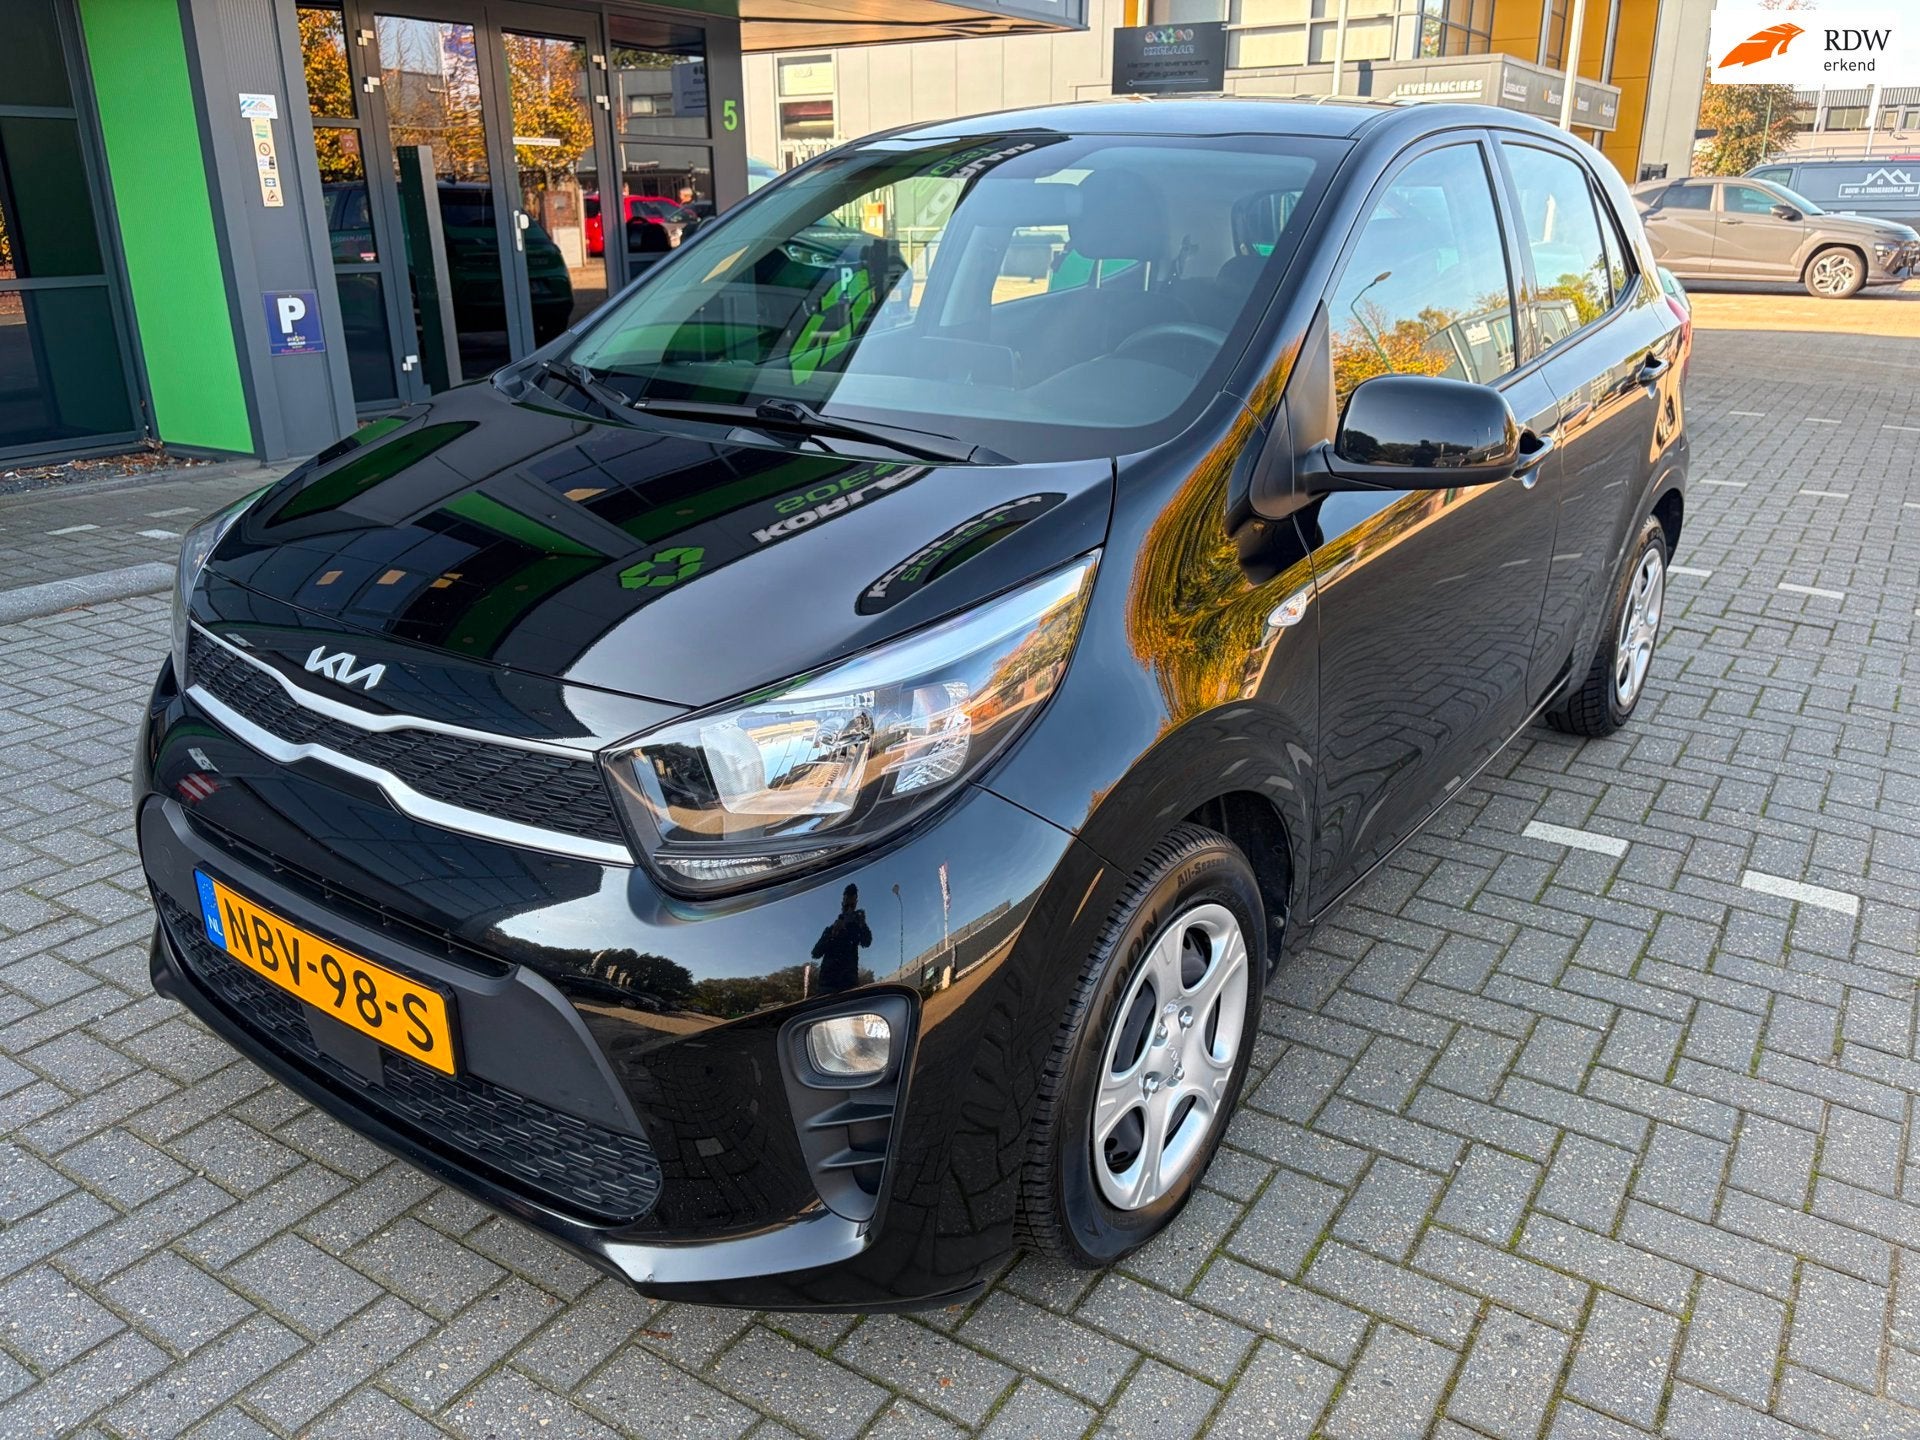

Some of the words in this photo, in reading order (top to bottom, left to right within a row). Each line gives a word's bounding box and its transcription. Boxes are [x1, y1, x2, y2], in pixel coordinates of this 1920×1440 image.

[1397, 79, 1483, 94] LEVERANCIERS
[723, 100, 738, 131] 5
[277, 298, 306, 334] P
[304, 645, 386, 690] KIA
[208, 914, 223, 937] NL
[224, 897, 434, 1052] NBV-98-S
